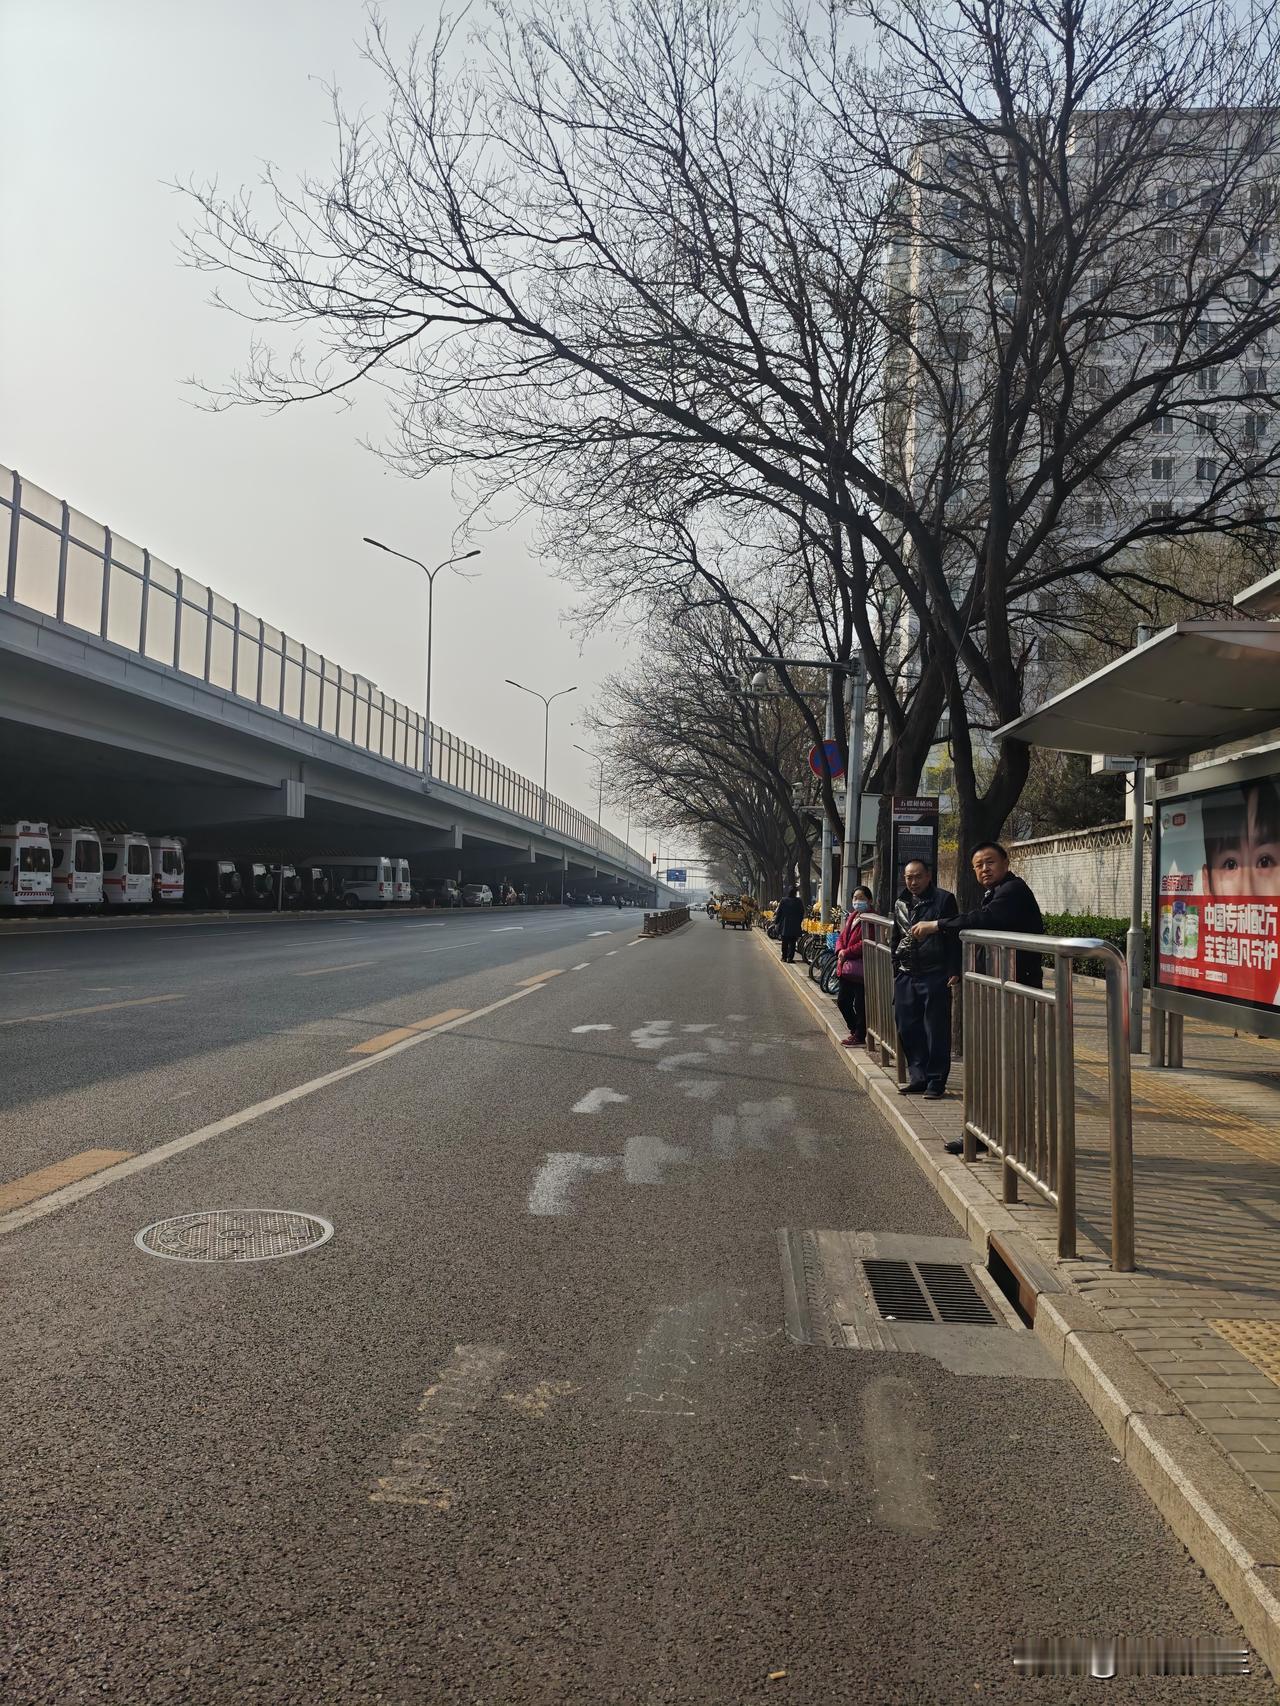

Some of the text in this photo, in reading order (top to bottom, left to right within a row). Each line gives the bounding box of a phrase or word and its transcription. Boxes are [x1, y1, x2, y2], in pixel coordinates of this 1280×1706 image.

[1204, 903, 1278, 936] 中国专利配方
[1204, 935, 1278, 970] 宝宝超凡守护
